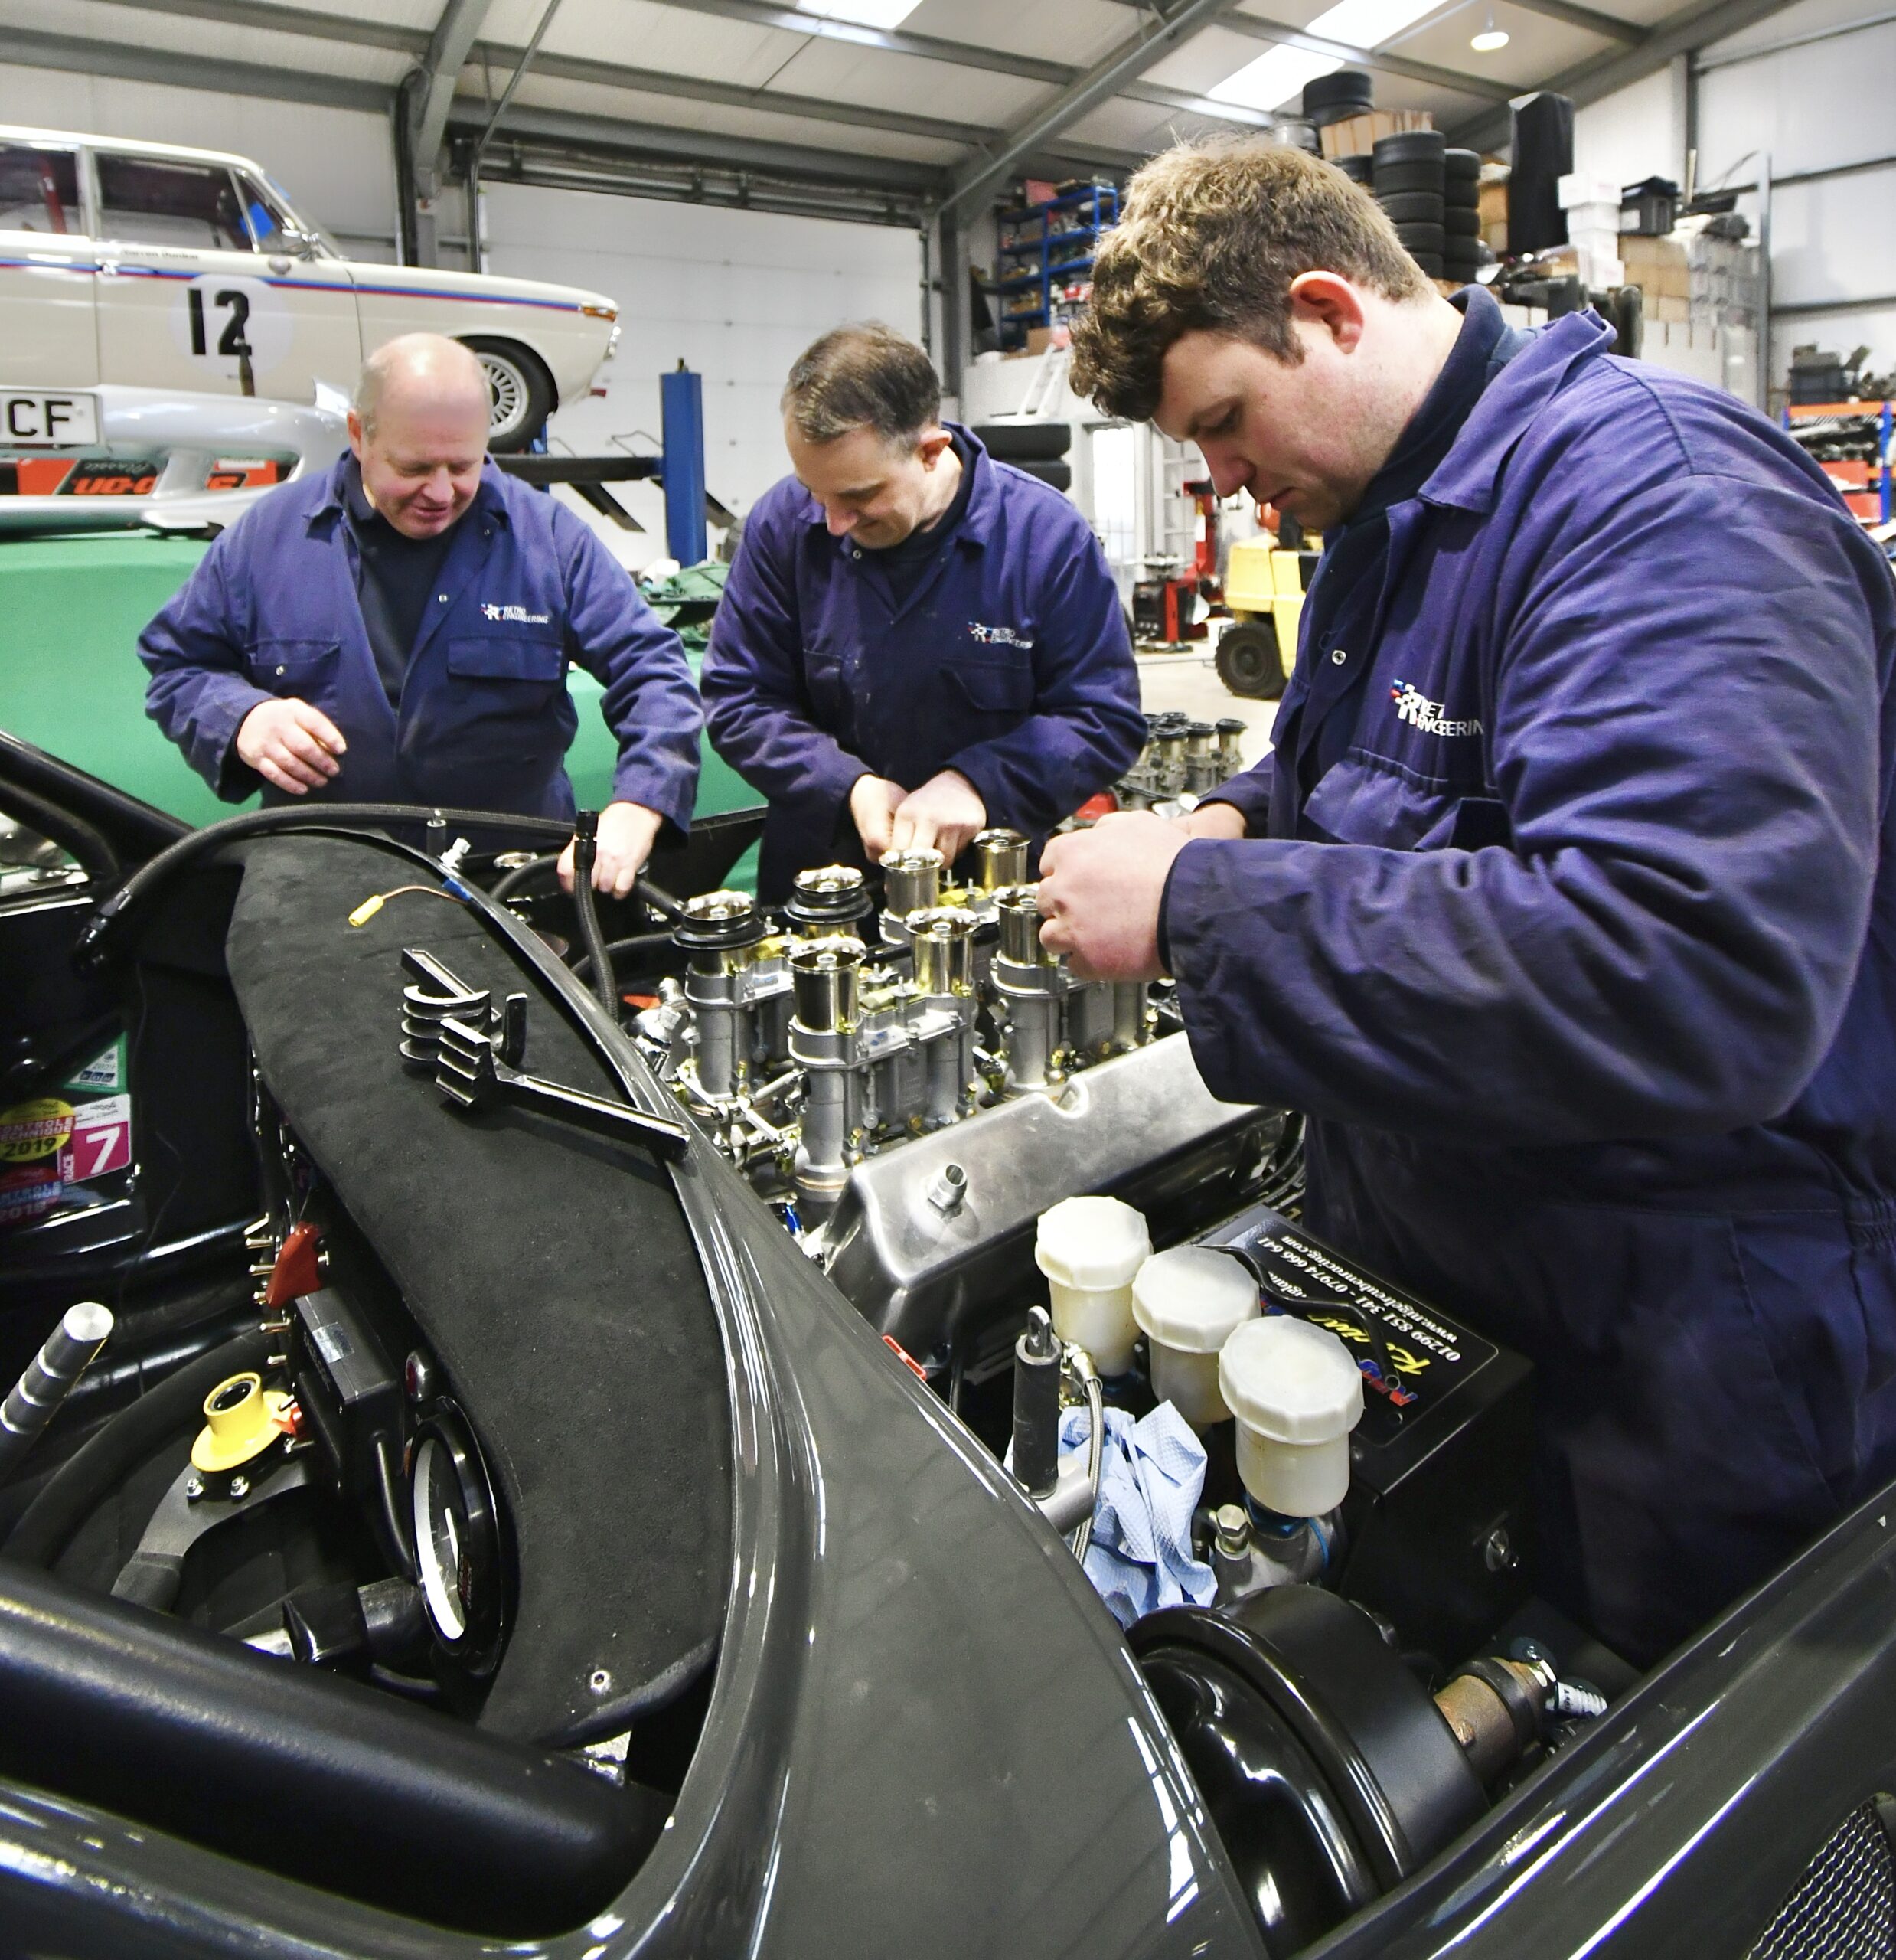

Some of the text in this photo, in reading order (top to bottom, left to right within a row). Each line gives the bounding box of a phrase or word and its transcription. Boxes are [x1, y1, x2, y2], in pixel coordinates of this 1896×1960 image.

[188, 288, 253, 356] 12
[4, 1137, 57, 1158] 2019
[86, 1127, 121, 1175] 7
[1258, 1237, 1284, 1253] 641
[1280, 1250, 1307, 1269] 666
[1281, 1235, 1457, 1344] www.nigelreubenracing.com
[1304, 1266, 1348, 1294] 07974
[1357, 1296, 1386, 1315] 341
[1382, 1314, 1414, 1334] 851
[1411, 1331, 1461, 1362] 01299
